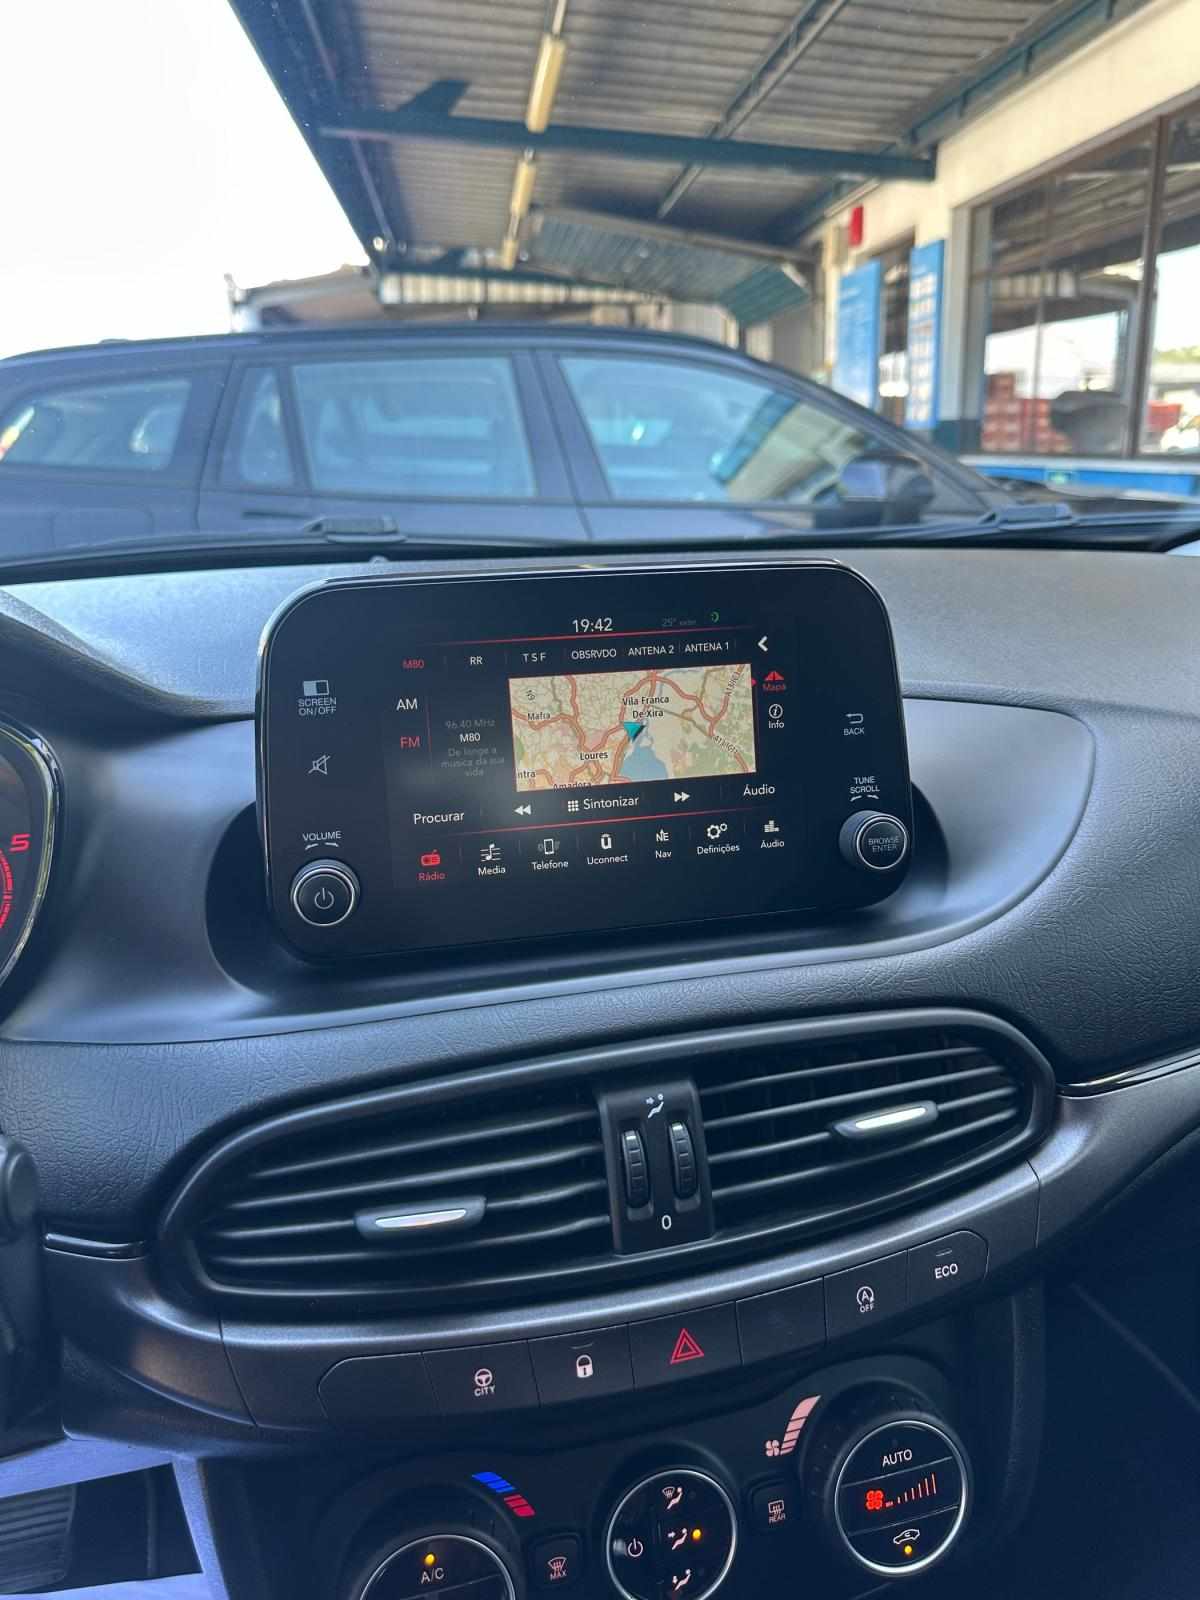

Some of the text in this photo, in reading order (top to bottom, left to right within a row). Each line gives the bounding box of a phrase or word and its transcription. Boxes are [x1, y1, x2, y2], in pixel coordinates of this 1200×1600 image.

[571, 617, 613, 633] 19:42
[627, 645, 675, 657] ANTENA 2
[684, 643, 722, 653] ANTENA
[571, 649, 617, 660] OBSRVDO
[402, 659, 425, 669] M80
[469, 656, 483, 666] RR
[763, 683, 787, 693] Mapa
[298, 697, 337, 707] SCREEN
[396, 698, 418, 711] AM
[622, 695, 670, 706] Vila Franca
[298, 706, 337, 716] ON/OFF
[632, 709, 664, 719] De Xira
[768, 720, 785, 730] Info
[843, 727, 865, 736] BACK
[400, 736, 420, 749] FM
[459, 732, 481, 743] M80
[579, 751, 609, 761] Loures
[853, 776, 876, 785] TUNE
[743, 784, 776, 797] Áudio
[850, 785, 881, 794] SCROLL
[583, 796, 640, 810] Sintonizar
[413, 811, 465, 825] Procurar
[302, 831, 342, 842] VOLUME
[868, 836, 900, 846] BROWSE
[760, 839, 785, 849] Áudio
[872, 844, 897, 853] ENTER
[655, 850, 672, 860] Nav
[696, 844, 741, 856] Definições
[531, 860, 569, 871] Telefone
[586, 854, 629, 866] Uconnect
[418, 871, 445, 881] Rádio
[477, 865, 506, 877] Media
[661, 1214, 673, 1231] 0
[934, 1263, 959, 1279] ECO
[859, 1303, 875, 1313] OFF
[474, 1384, 495, 1397] CITY
[881, 1449, 914, 1467] AUTO
[420, 1567, 446, 1585] A/C
